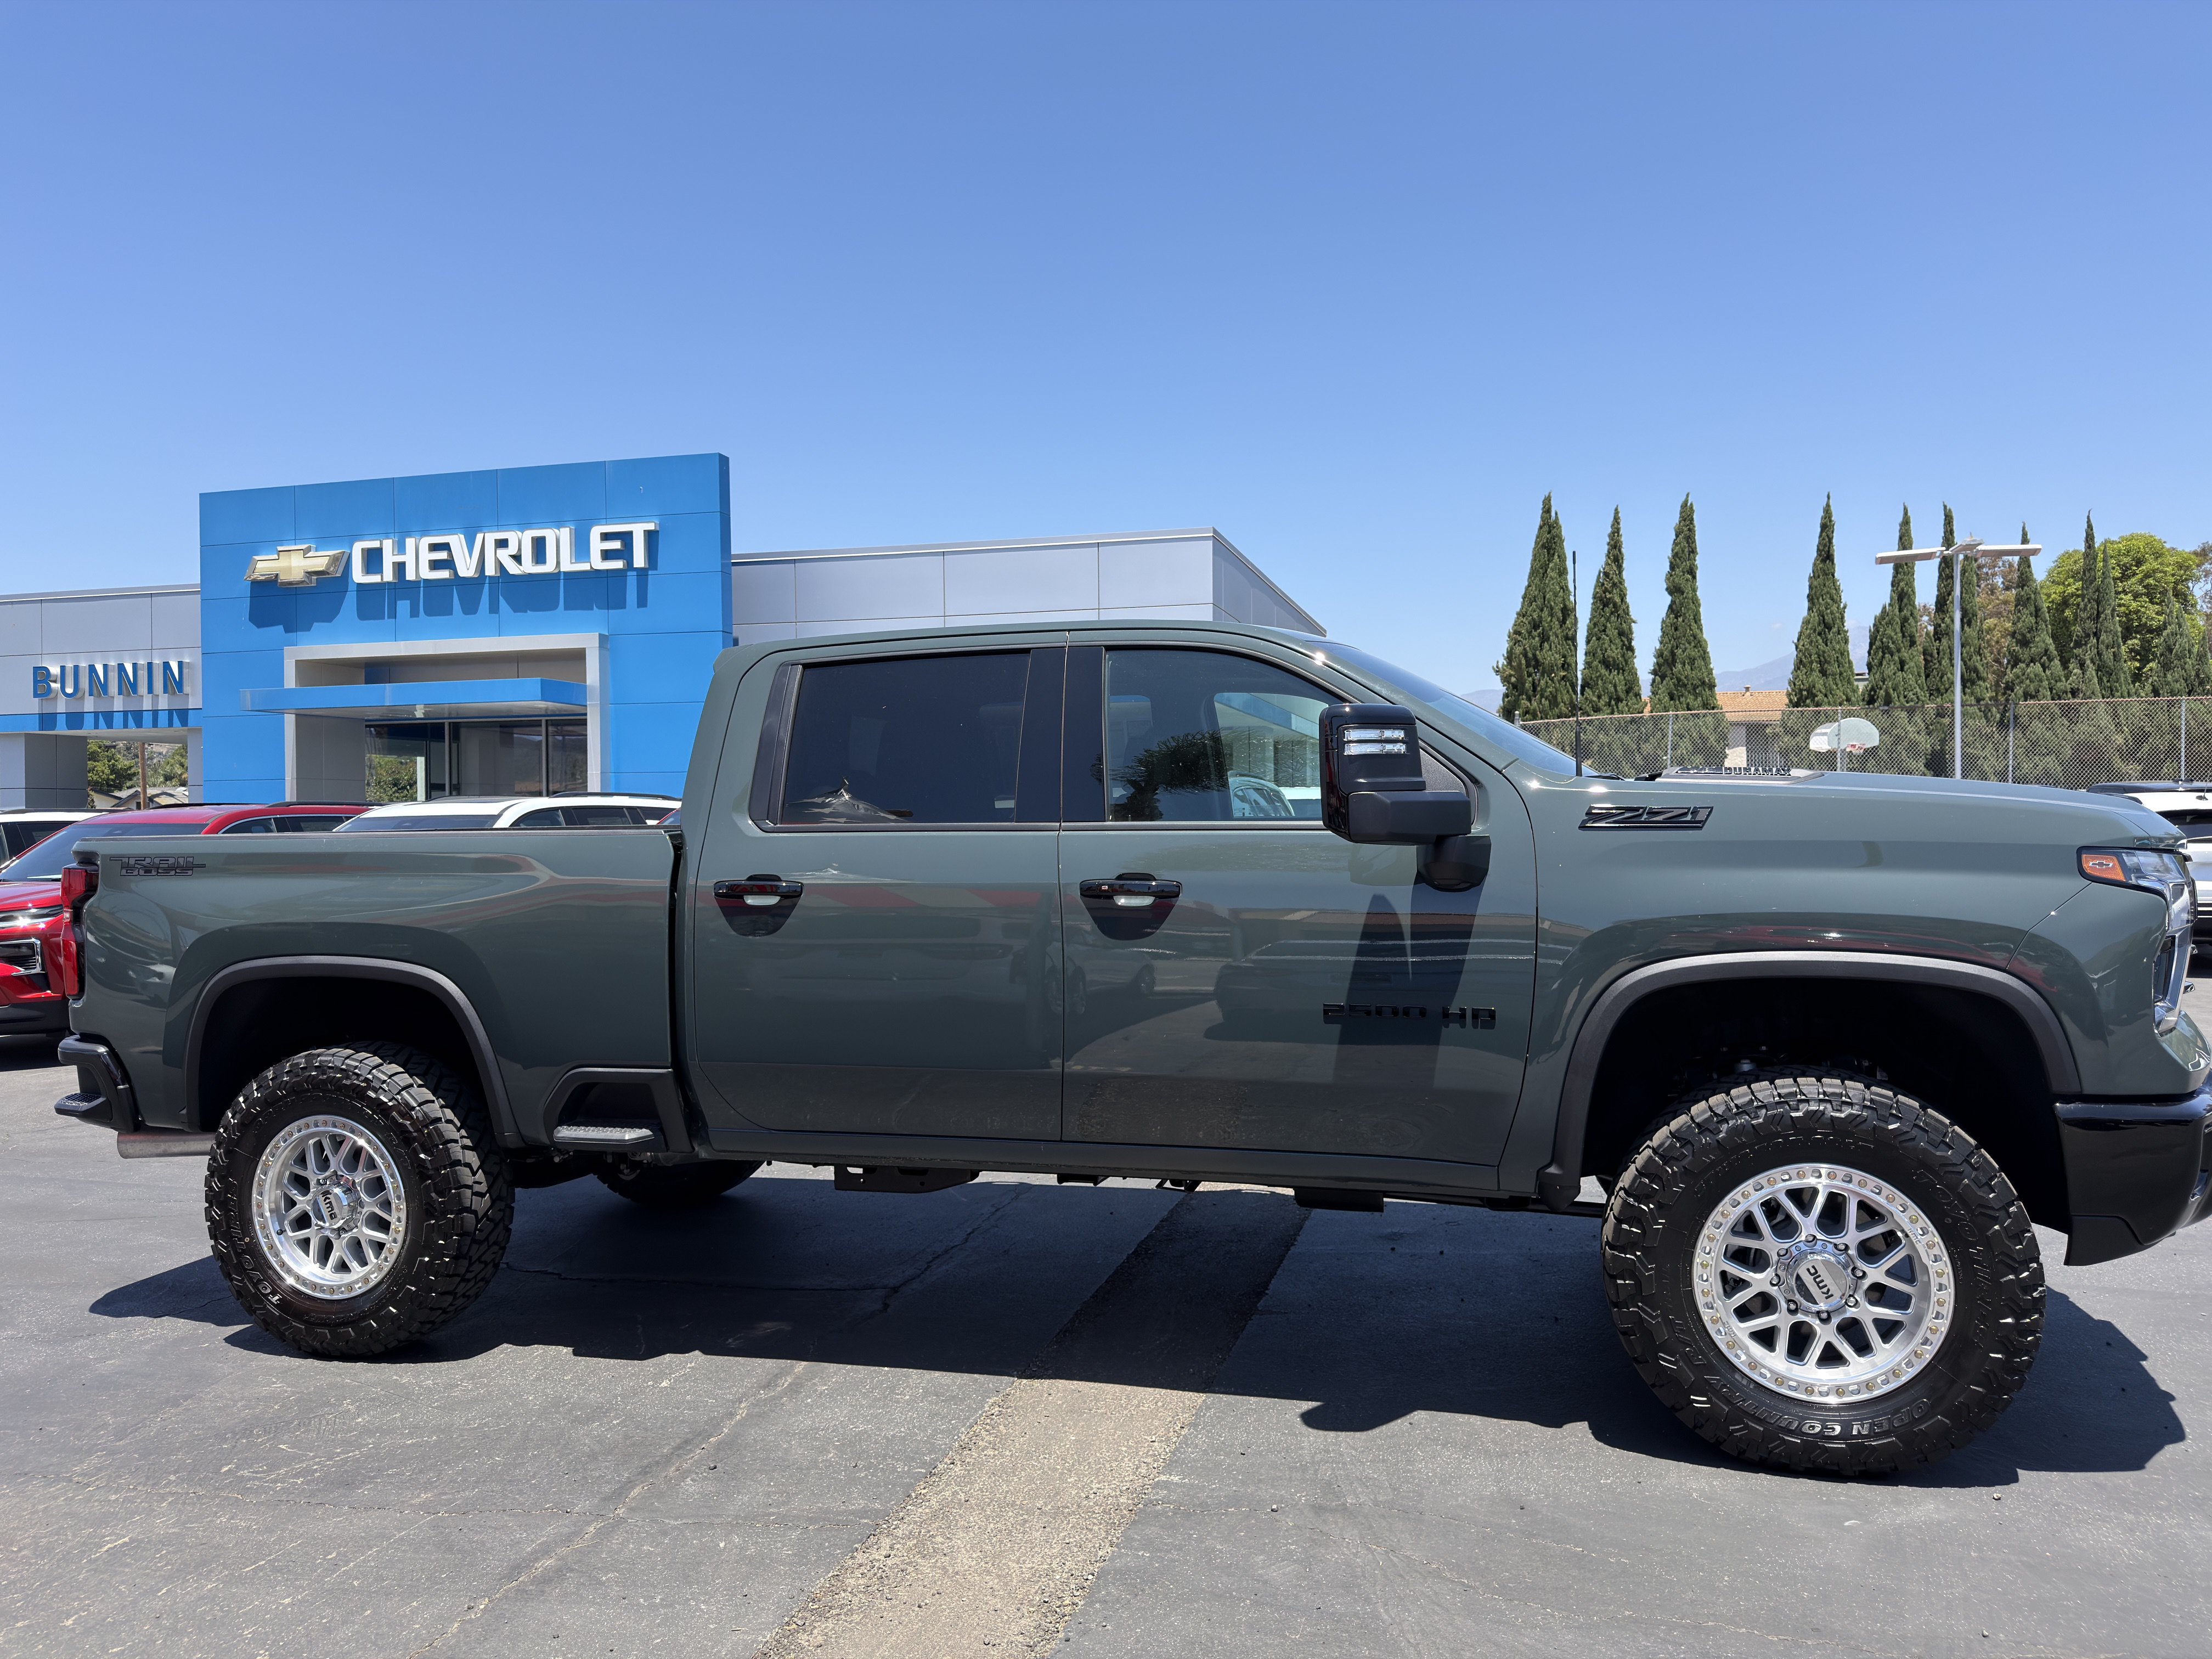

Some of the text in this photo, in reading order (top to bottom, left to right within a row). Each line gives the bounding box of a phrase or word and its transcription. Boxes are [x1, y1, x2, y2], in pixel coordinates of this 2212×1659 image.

[352, 521, 659, 584] CHEVROLET
[32, 661, 190, 699] BUNNIN
[1724, 766, 1792, 776] DURAMAX
[1578, 804, 1714, 831] Z71
[110, 856, 206, 868] TRAIL
[120, 867, 193, 876] BOSS
[1323, 1003, 1497, 1024] 2500 HD
[1851, 1398, 1932, 1436] OPEN
